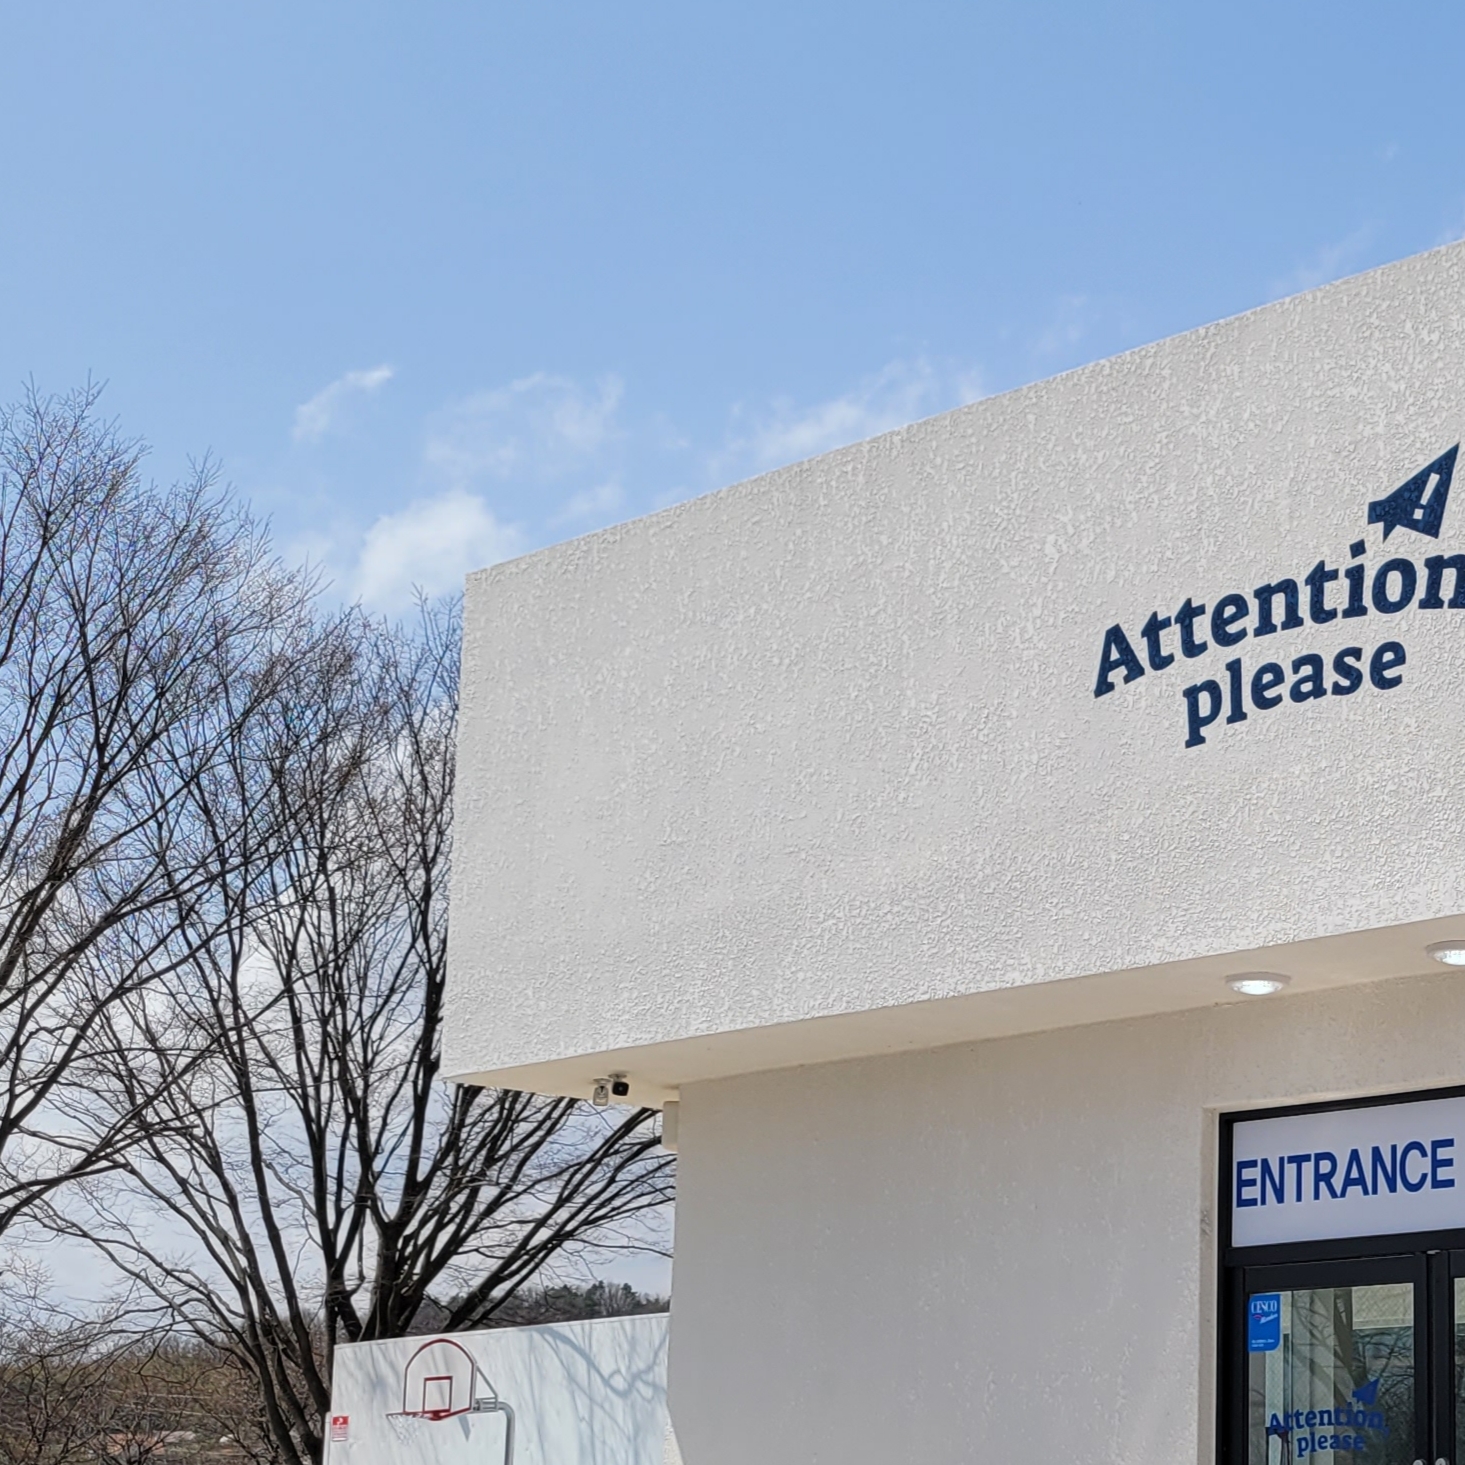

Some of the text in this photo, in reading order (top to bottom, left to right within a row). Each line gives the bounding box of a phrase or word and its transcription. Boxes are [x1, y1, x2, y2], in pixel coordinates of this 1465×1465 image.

[1182, 640, 1407, 749] please
[1235, 1138, 1455, 1208] ENTRANCE
[1296, 1431, 1366, 1458] please
